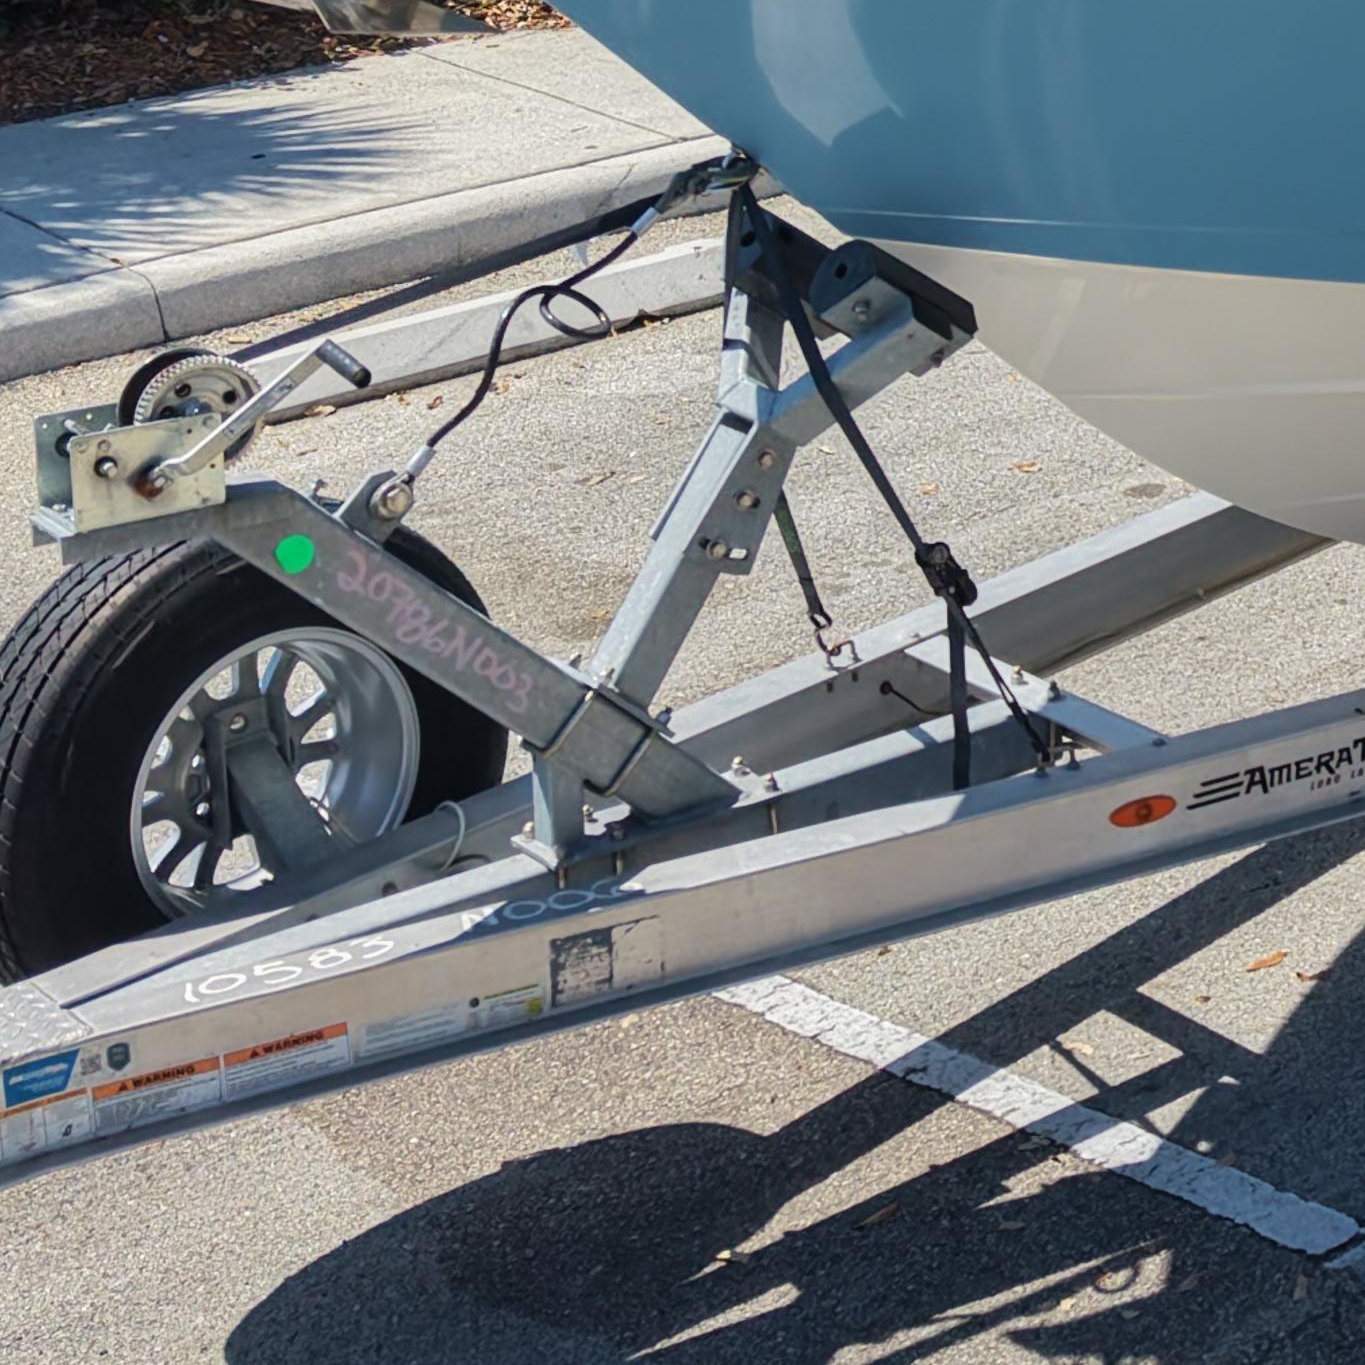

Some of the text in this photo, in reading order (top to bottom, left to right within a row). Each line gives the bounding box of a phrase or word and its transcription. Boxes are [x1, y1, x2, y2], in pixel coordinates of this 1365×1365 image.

[183, 935, 395, 1003] 10583
[262, 1030, 325, 1055] WARNING
[132, 1064, 196, 1090] WARNING
